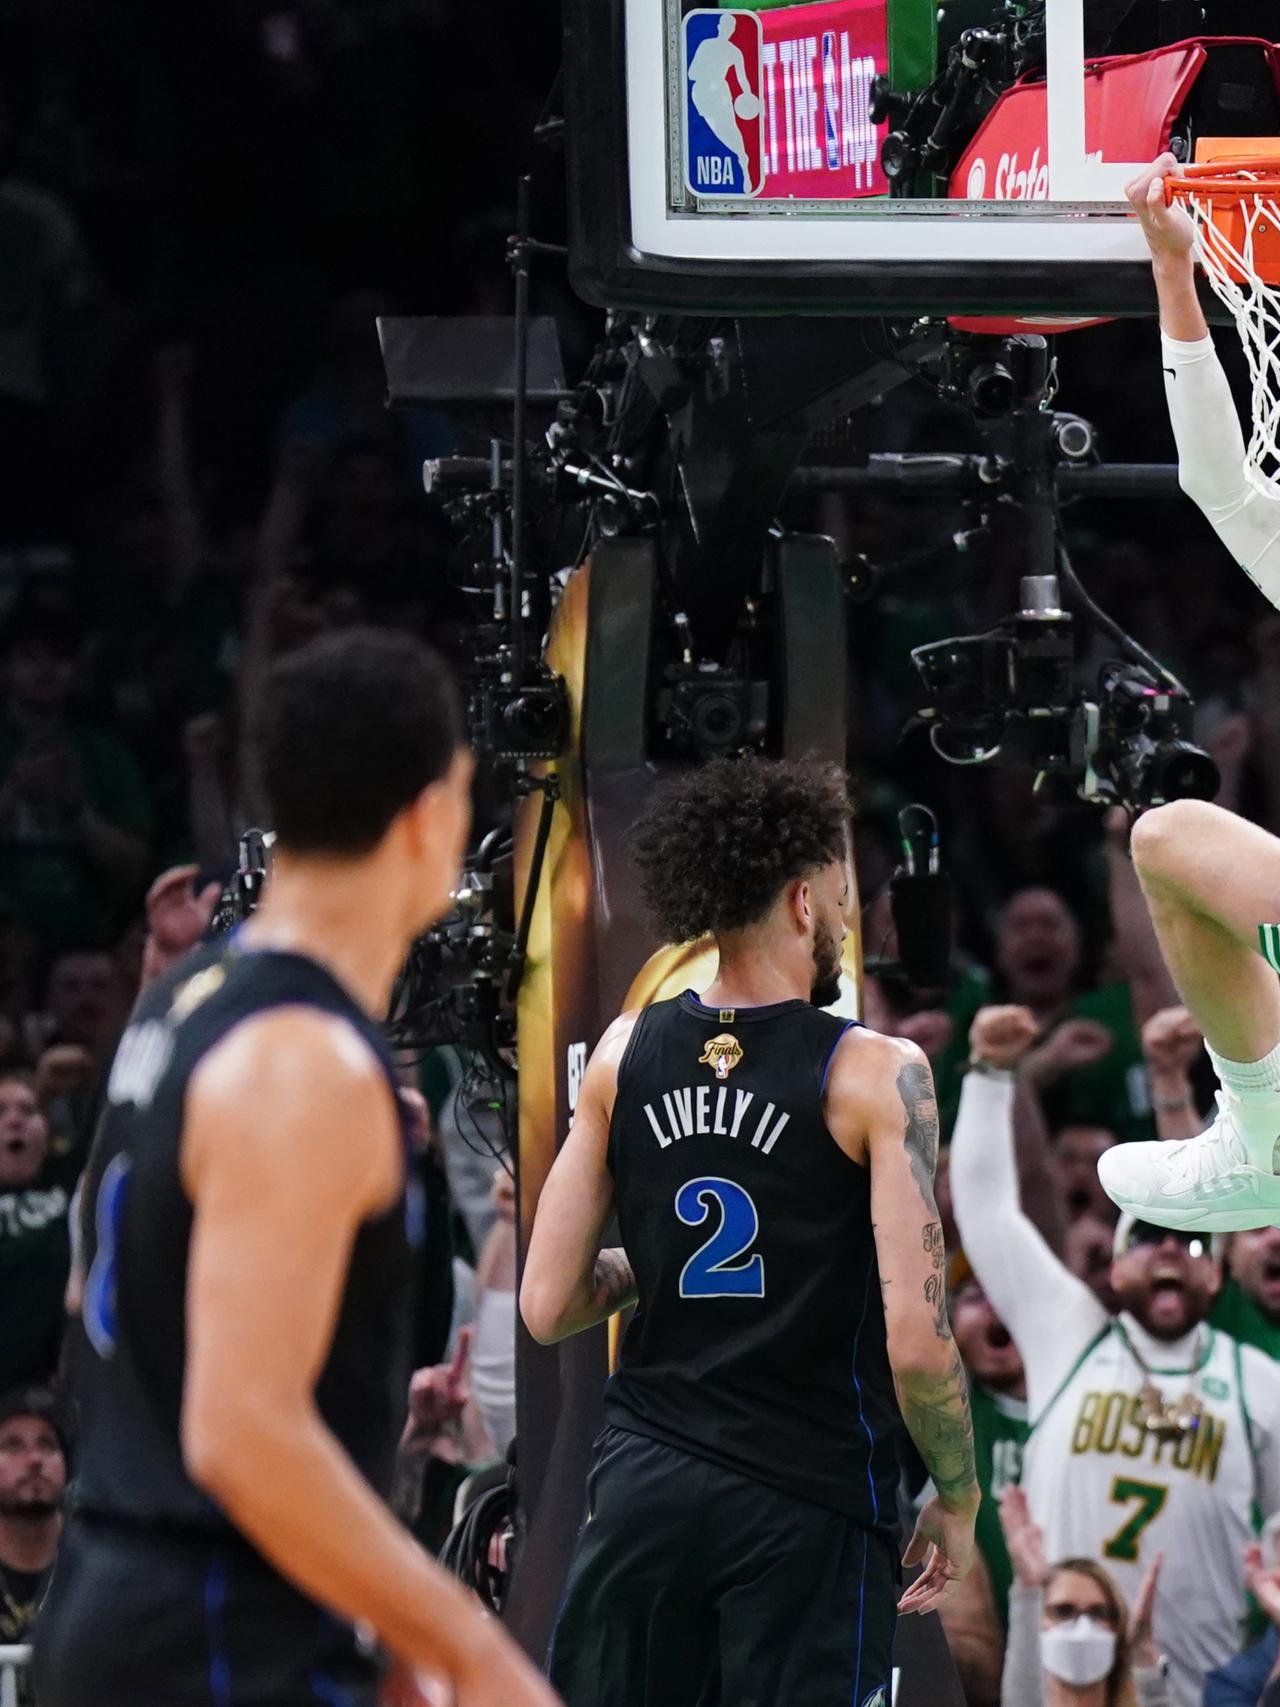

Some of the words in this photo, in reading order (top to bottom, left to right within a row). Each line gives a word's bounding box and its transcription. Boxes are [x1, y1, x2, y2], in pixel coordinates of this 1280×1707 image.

[779, 36, 823, 173] THE
[697, 155, 735, 186] NBA
[995, 147, 1049, 200] State
[700, 1041, 742, 1061] Finals
[643, 1085, 754, 1149] LIVELY
[750, 1101, 791, 1156] II
[674, 1175, 766, 1299] 2
[1103, 1477, 1168, 1564] 7
